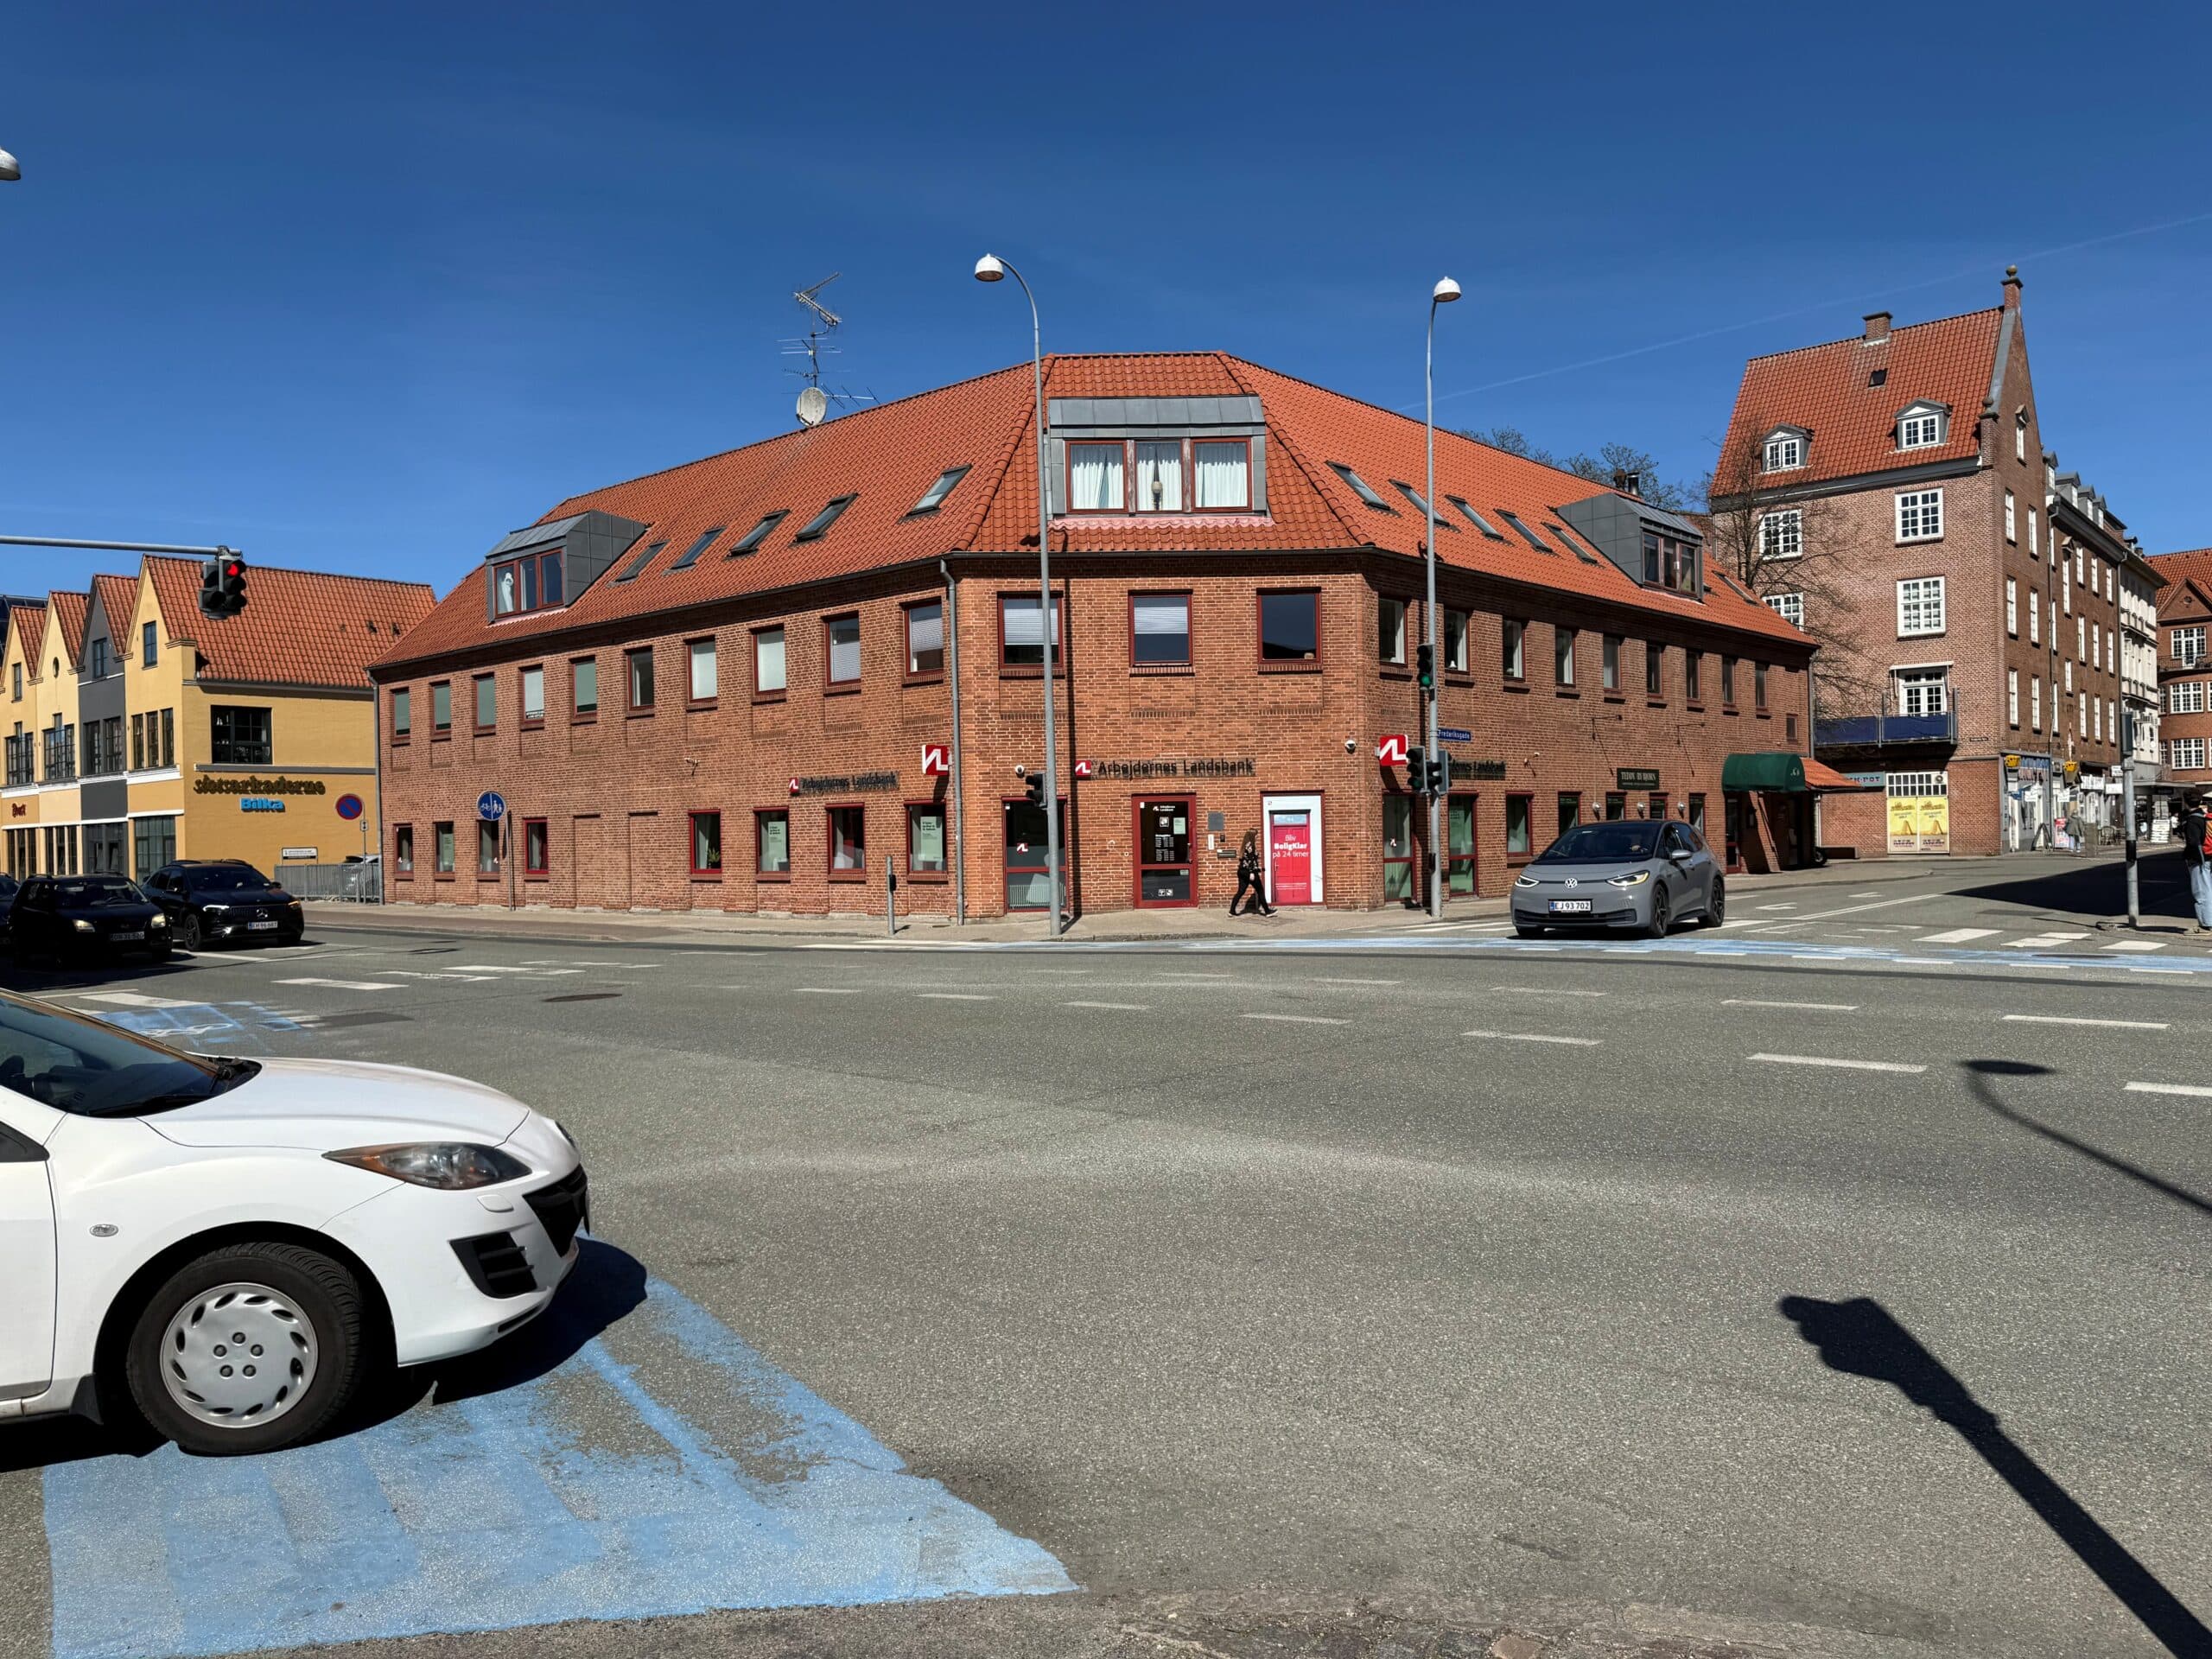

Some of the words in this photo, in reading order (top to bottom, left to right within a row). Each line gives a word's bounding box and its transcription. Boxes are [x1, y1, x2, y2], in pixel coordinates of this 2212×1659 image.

[1098, 760, 1177, 779] Arbejdernes
[1183, 758, 1254, 776] Landsbank
[240, 798, 285, 812] Bilka
